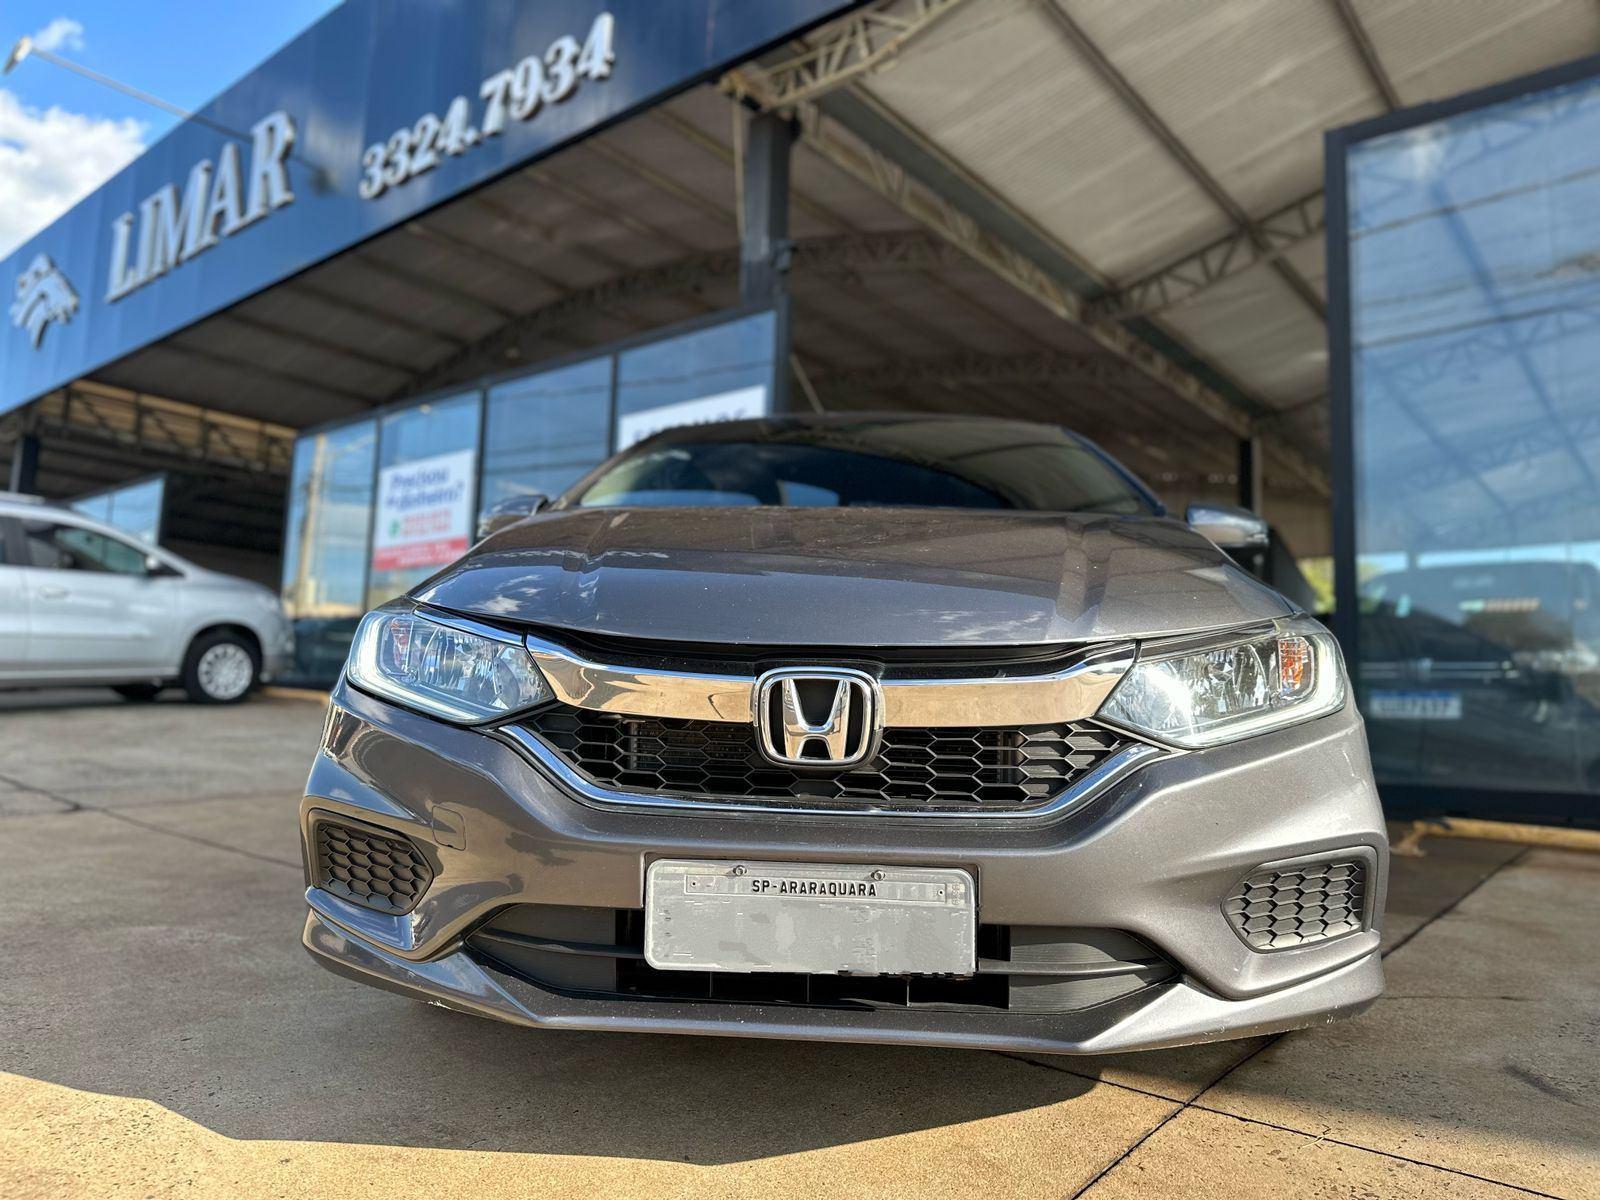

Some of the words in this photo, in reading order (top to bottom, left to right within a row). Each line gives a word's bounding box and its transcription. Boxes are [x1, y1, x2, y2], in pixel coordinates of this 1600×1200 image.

[359, 11, 616, 200] 3324.7934
[105, 110, 297, 303] LIMAR
[752, 879, 877, 896] SP-ARARAQUARA
